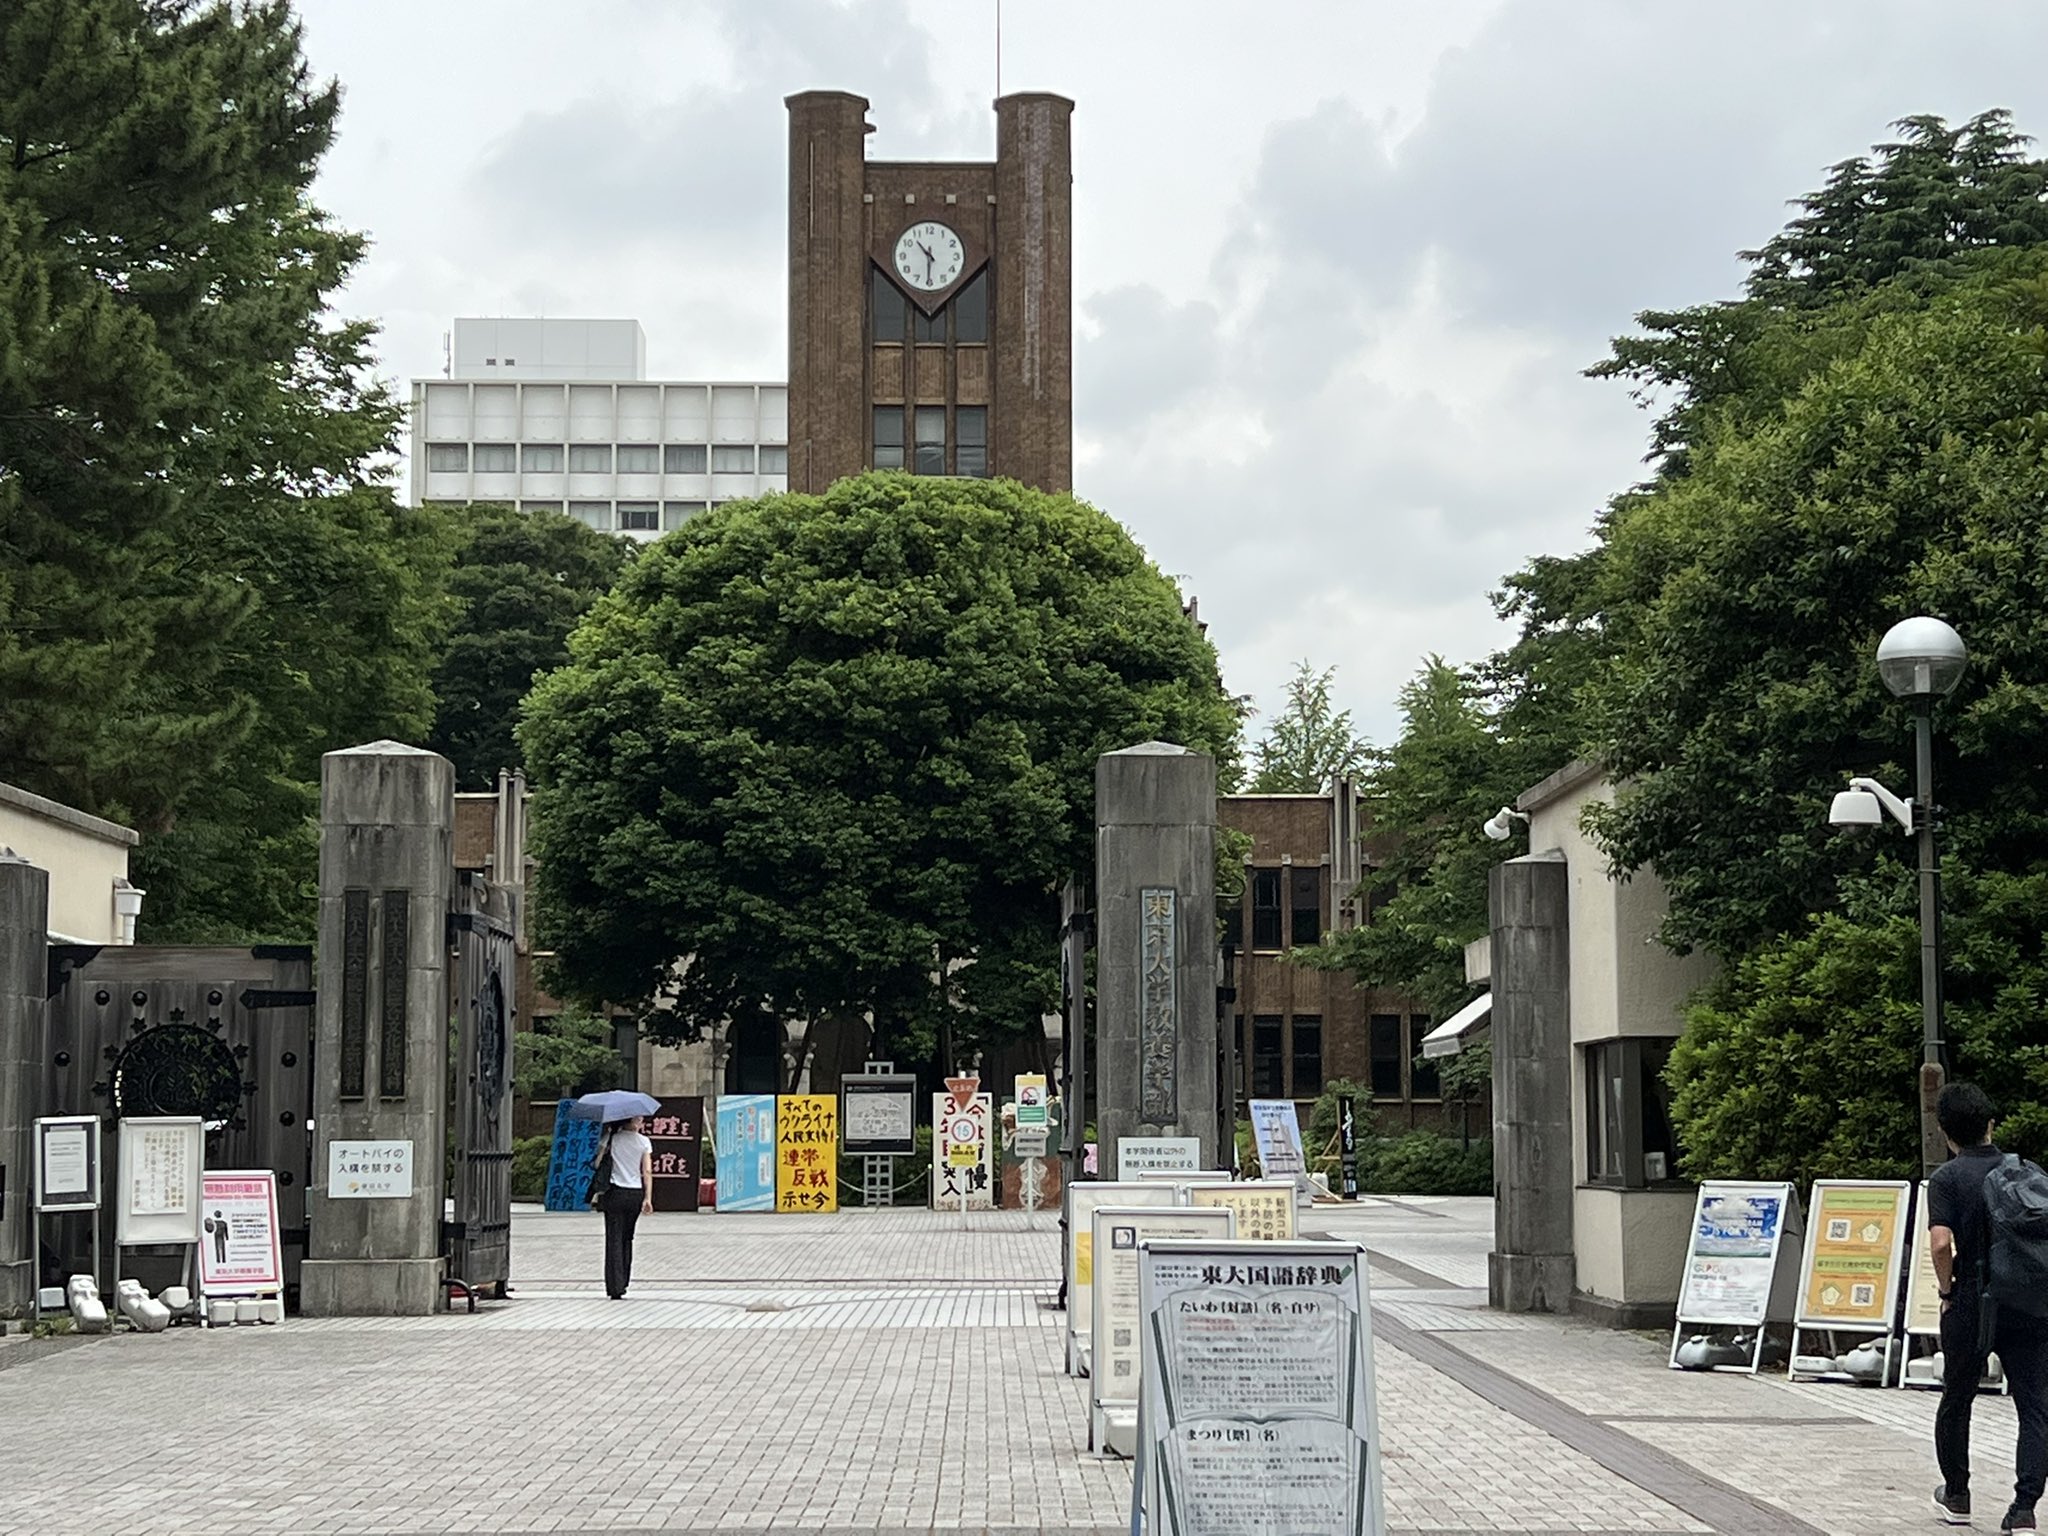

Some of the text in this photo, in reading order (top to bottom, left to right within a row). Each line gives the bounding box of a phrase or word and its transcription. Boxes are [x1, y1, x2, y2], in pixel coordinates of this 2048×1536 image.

[913, 229, 922, 238] 11
[925, 226, 935, 235] 12
[941, 230, 945, 238] 1
[903, 239, 913, 247] 10
[949, 239, 957, 248] 2
[899, 252, 906, 260] 9
[953, 252, 960, 261] 3
[948, 265, 956, 273] 4
[913, 274, 921, 282] 7
[940, 275, 947, 283] 5
[783, 1099, 823, 1112] すべての
[780, 1113, 834, 1129] ウクライナ
[956, 1124, 969, 1137] 15
[338, 1148, 405, 1159] オートバイの
[792, 1169, 829, 1188] 反戦
[783, 1191, 830, 1209] 示せ今
[1201, 1264, 1343, 1286] 東大国語辞典
